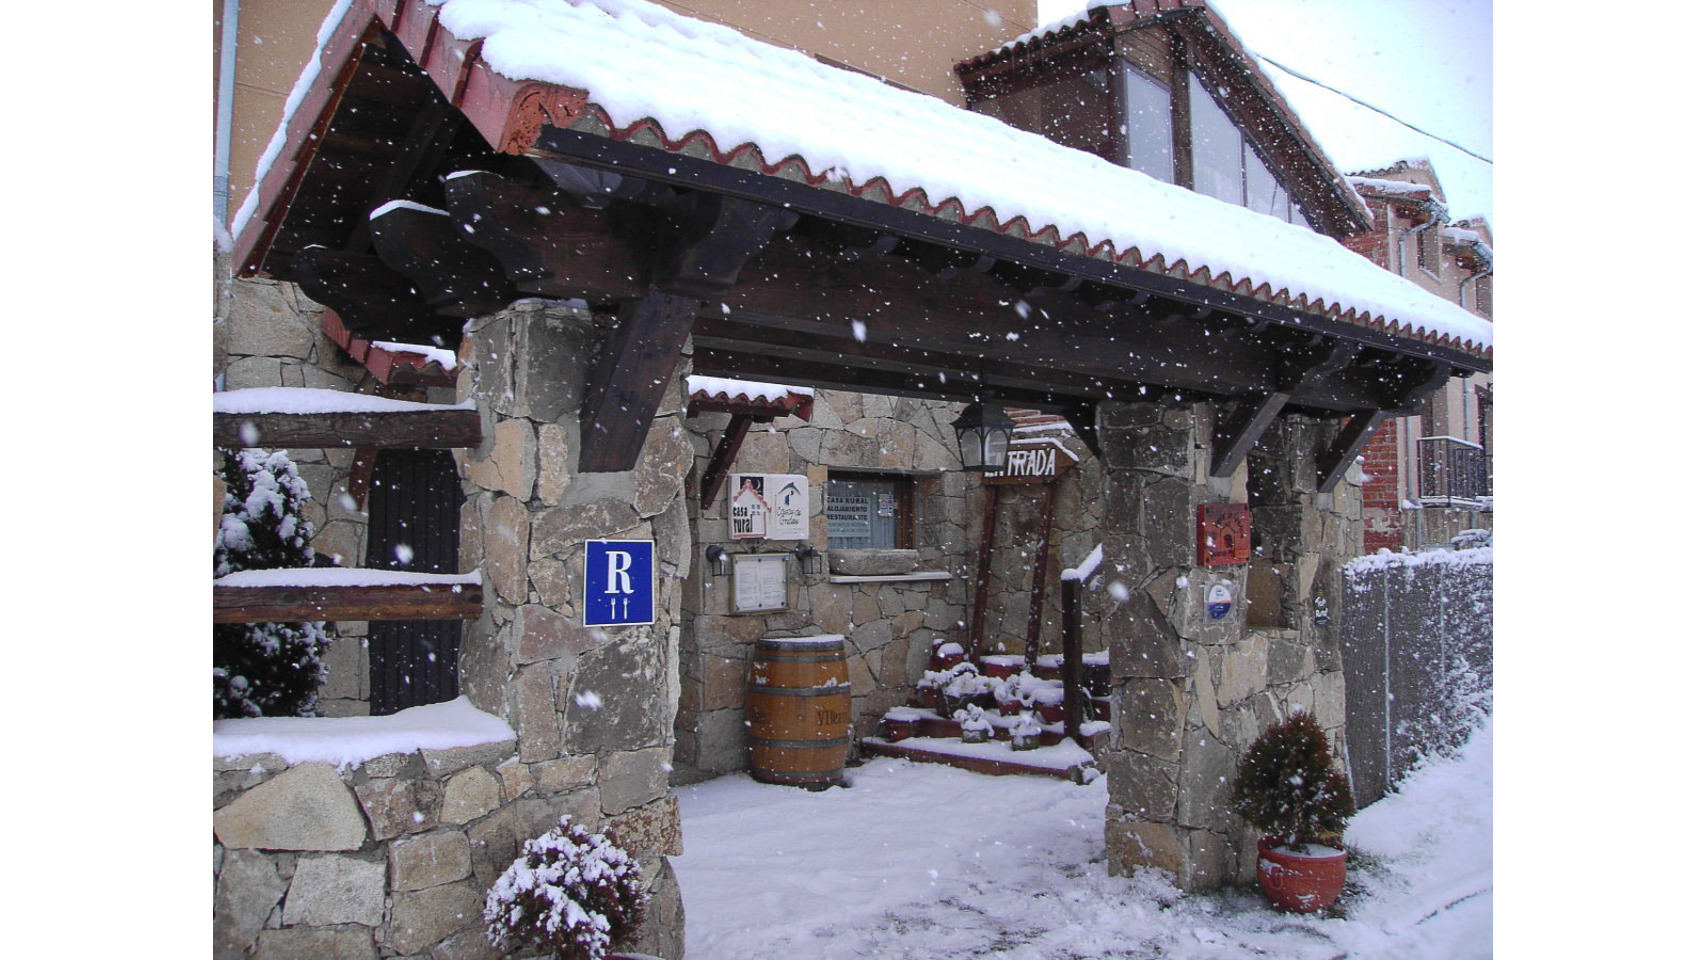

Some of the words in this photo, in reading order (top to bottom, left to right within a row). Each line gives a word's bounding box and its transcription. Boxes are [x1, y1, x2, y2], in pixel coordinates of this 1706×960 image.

[733, 507, 748, 517] casa
[733, 514, 753, 533] rural
[604, 550, 635, 594] R
